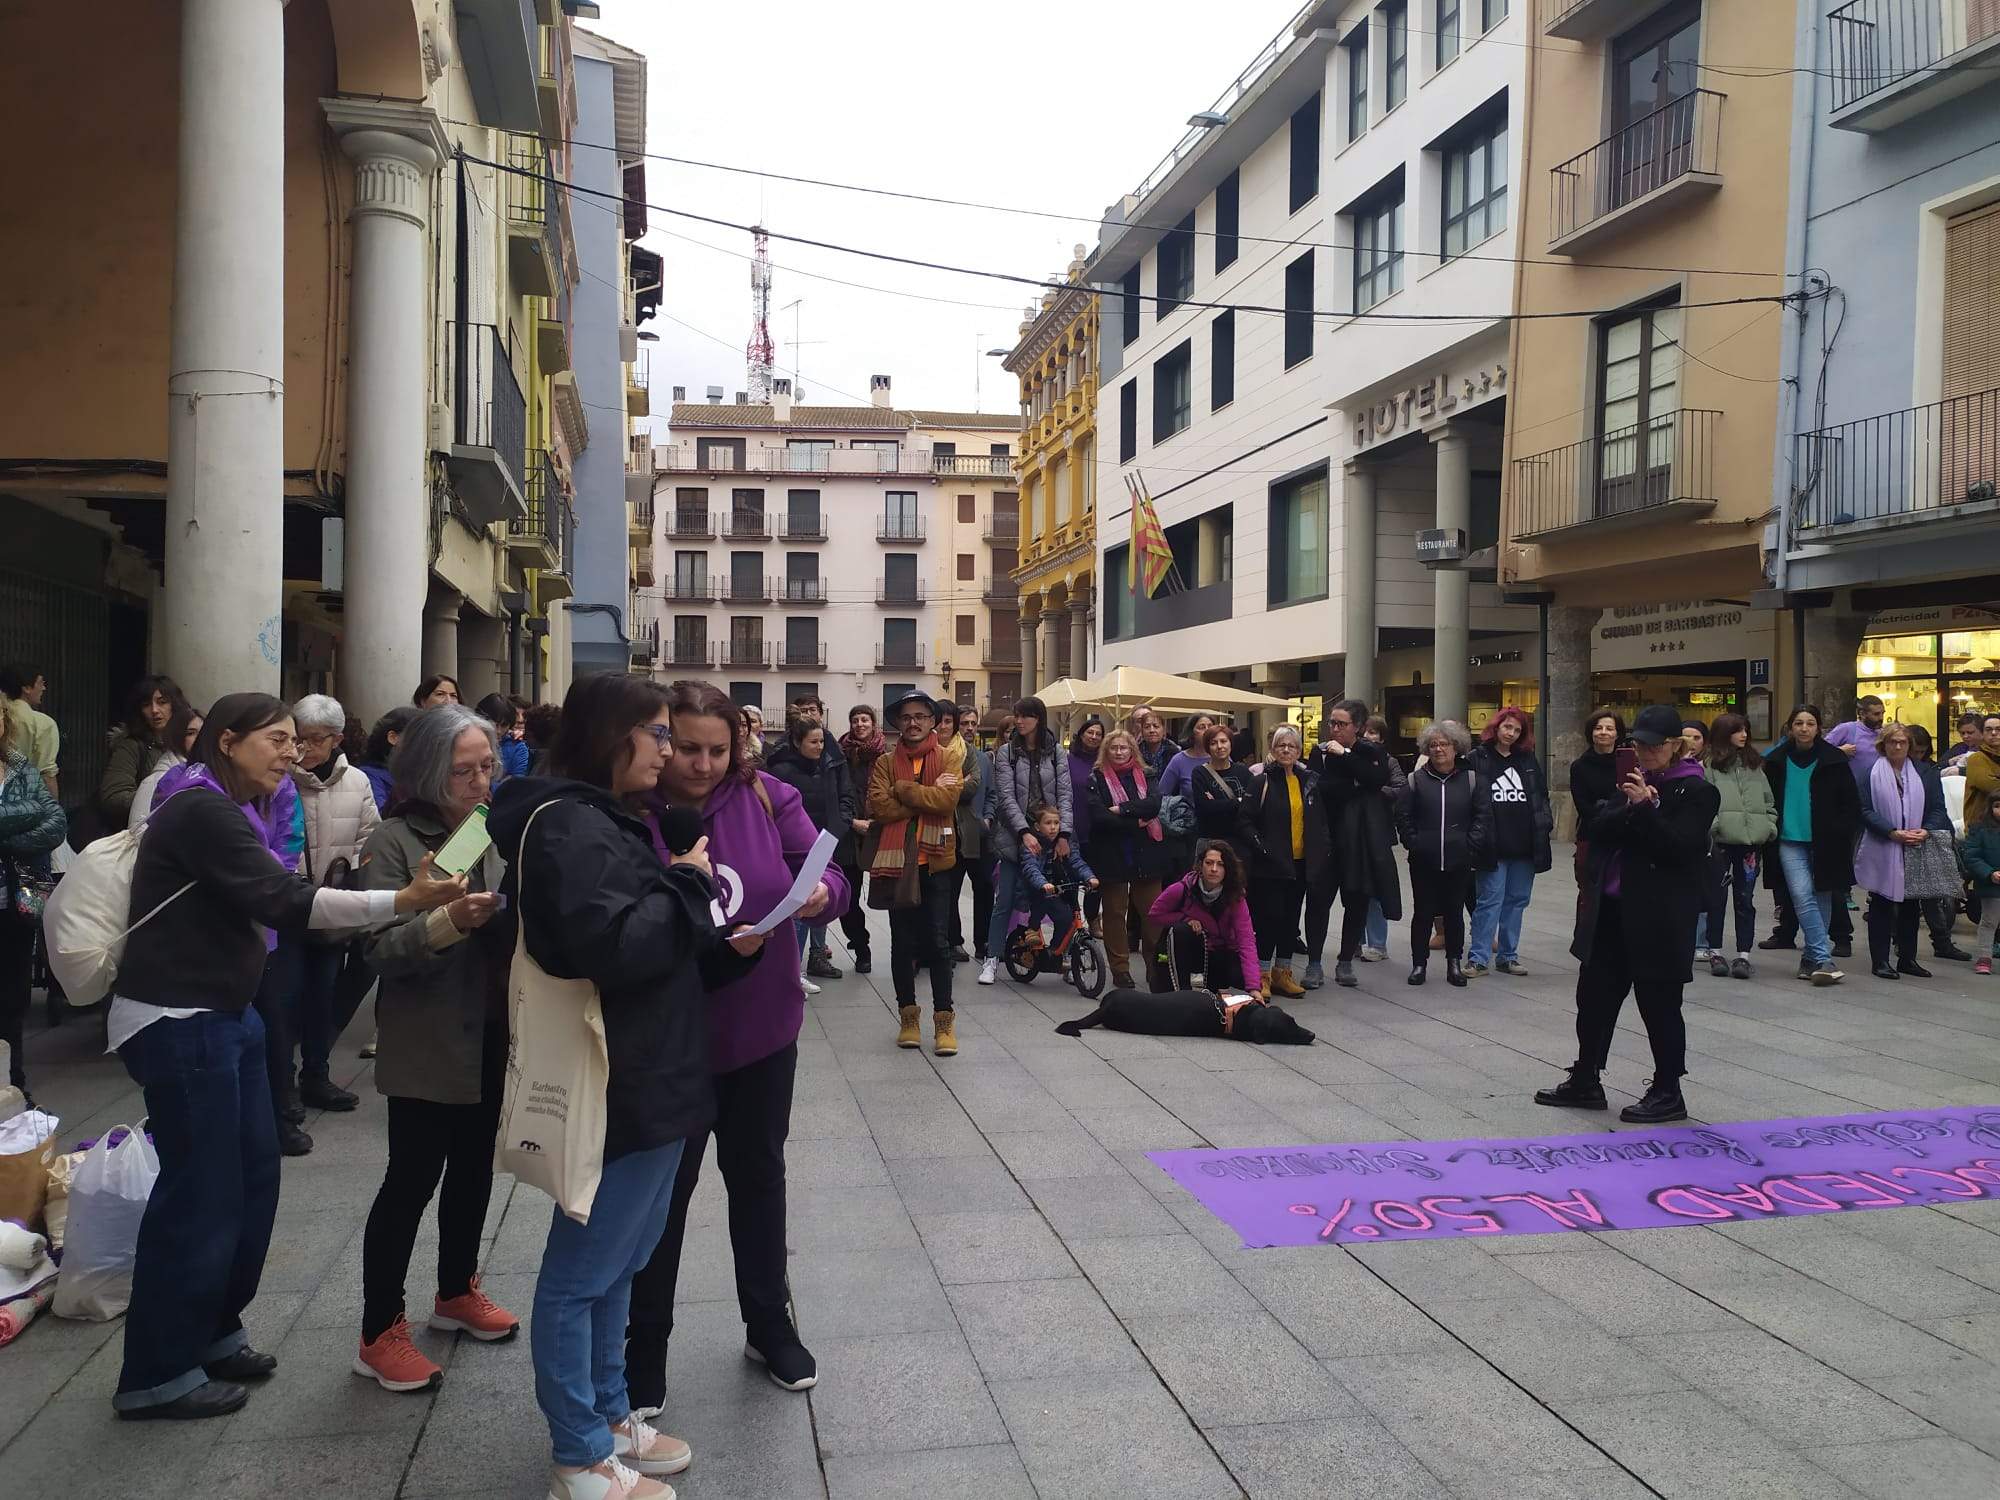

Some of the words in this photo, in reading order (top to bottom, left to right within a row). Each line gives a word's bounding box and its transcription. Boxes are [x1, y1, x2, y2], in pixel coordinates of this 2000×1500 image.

[1353, 374, 1457, 446] HOTEL
[1417, 539, 1457, 550] RESTAURANTE
[1600, 624, 1643, 640] CIUDAD
[1645, 620, 1662, 634] DE
[1664, 610, 1742, 632] BARBASTRO
[1869, 609, 1940, 625] lectricidad
[1754, 662, 1764, 675] H
[1482, 1188, 1606, 1228] AL
